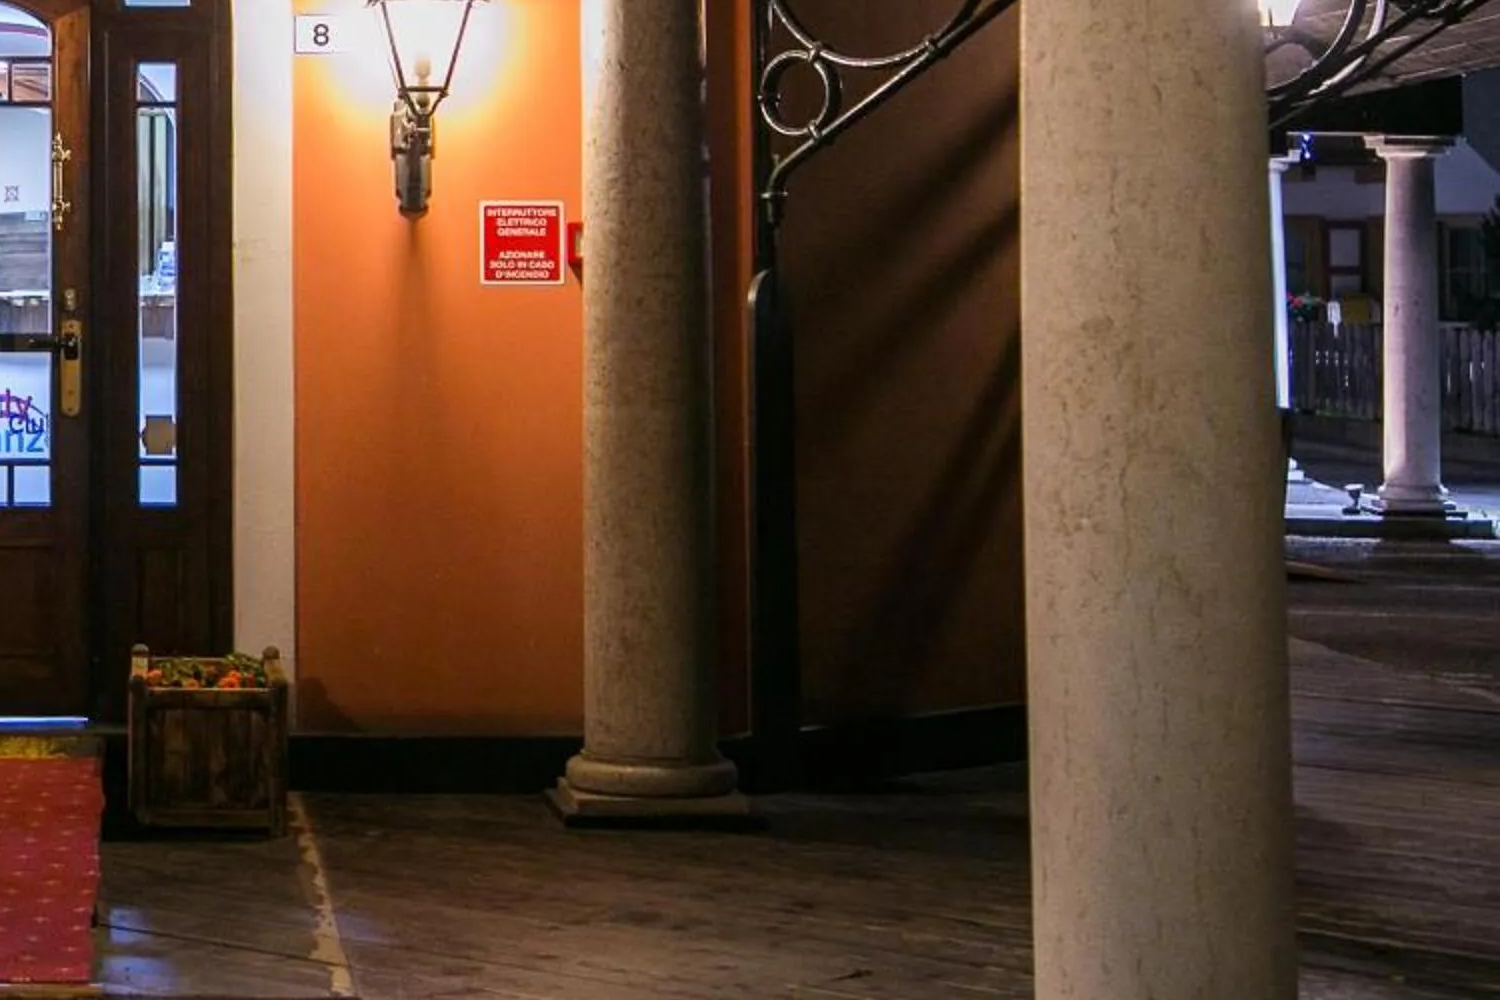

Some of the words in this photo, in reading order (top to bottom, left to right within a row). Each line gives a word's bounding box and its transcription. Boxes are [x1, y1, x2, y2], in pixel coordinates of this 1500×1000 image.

[313, 23, 329, 47] 8
[497, 217, 547, 226] ELETTRICO
[497, 228, 546, 237] GENERALE
[489, 260, 515, 269] SOLO
[529, 260, 555, 269] CASO
